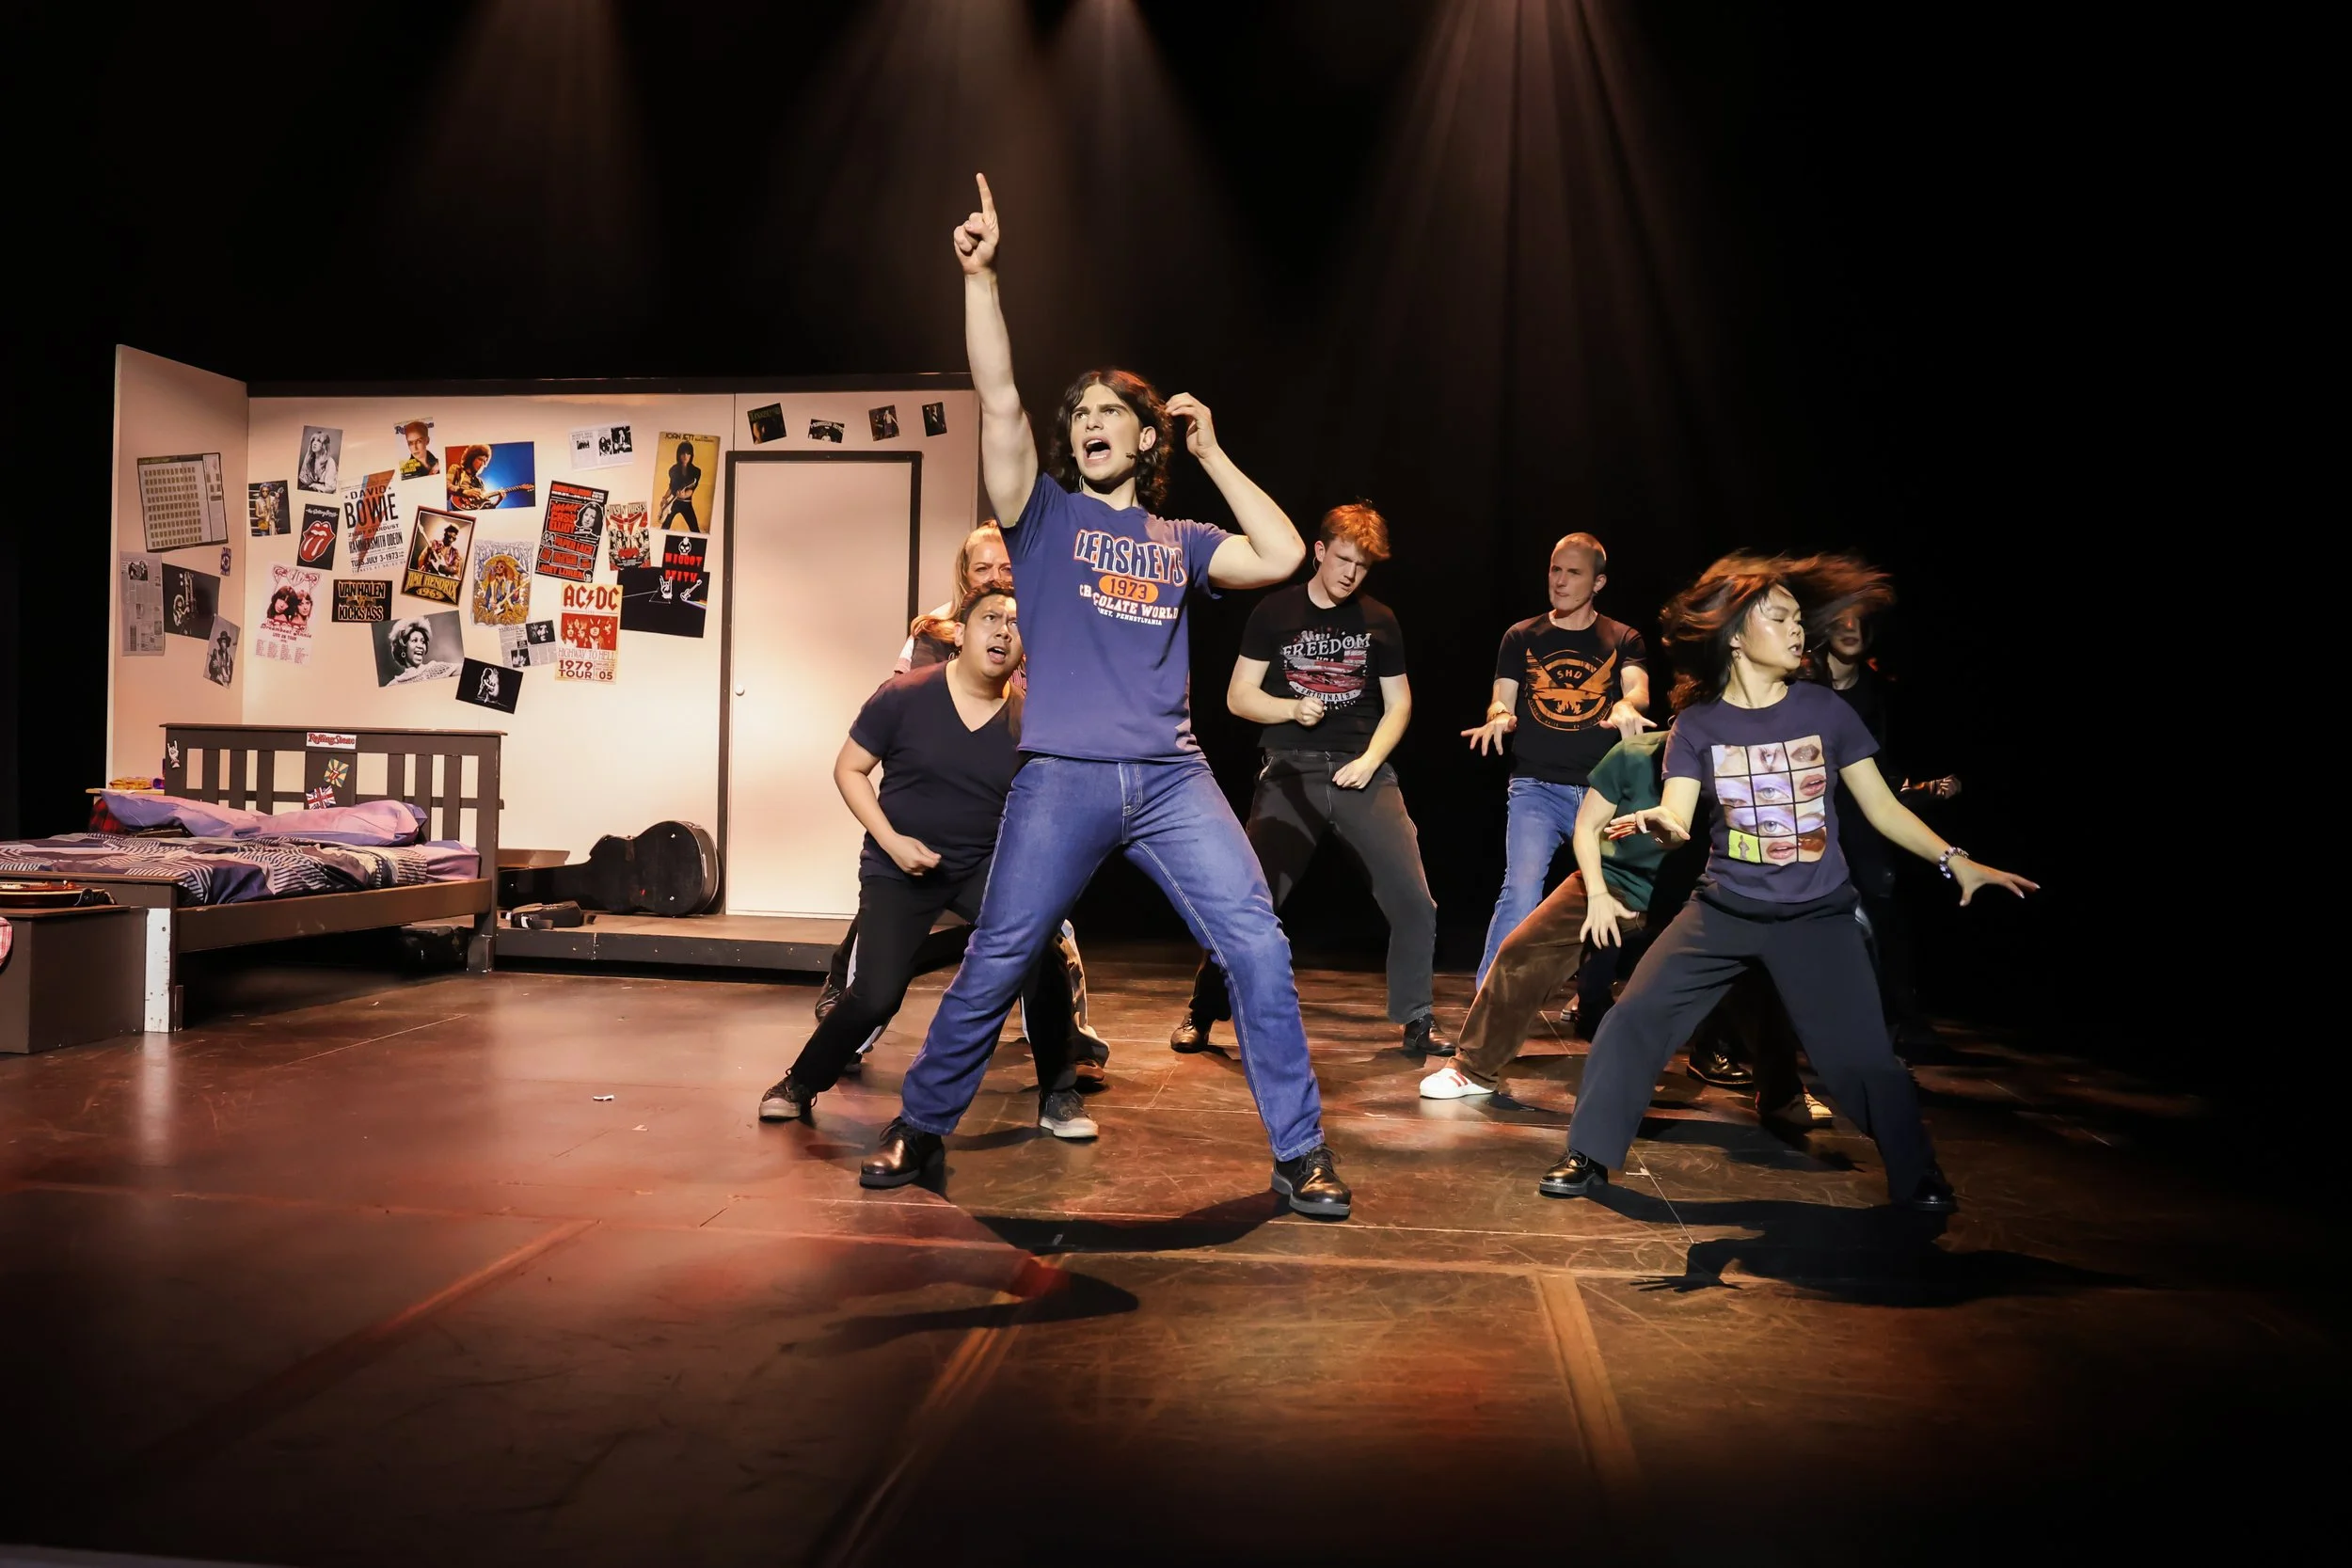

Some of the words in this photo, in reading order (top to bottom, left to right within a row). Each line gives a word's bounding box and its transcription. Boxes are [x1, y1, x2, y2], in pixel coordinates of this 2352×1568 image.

[350, 485, 387, 499] DAVID
[343, 493, 399, 529] BOWIE
[368, 523, 400, 533] STARDUST
[386, 531, 404, 546] ODEON
[338, 581, 357, 597] VAN
[357, 581, 386, 598] HALEN
[405, 571, 423, 589] JIMI
[423, 575, 460, 603] HENDRIX
[416, 588, 445, 599] 1969
[1109, 578, 1148, 600] 1973
[338, 604, 365, 621] KICKS
[365, 606, 384, 621] ASS
[1140, 603, 1179, 620] WORLD
[1116, 612, 1163, 626] PENNSYLVANIA
[1282, 632, 1372, 657] FREEDOM
[558, 647, 587, 659] HIGHWAY
[588, 650, 598, 659] TO
[598, 651, 615, 660] HELL
[559, 659, 594, 671] 1979
[558, 669, 593, 679] TOUR
[598, 671, 613, 680] 05
[1556, 669, 1583, 679] SHD
